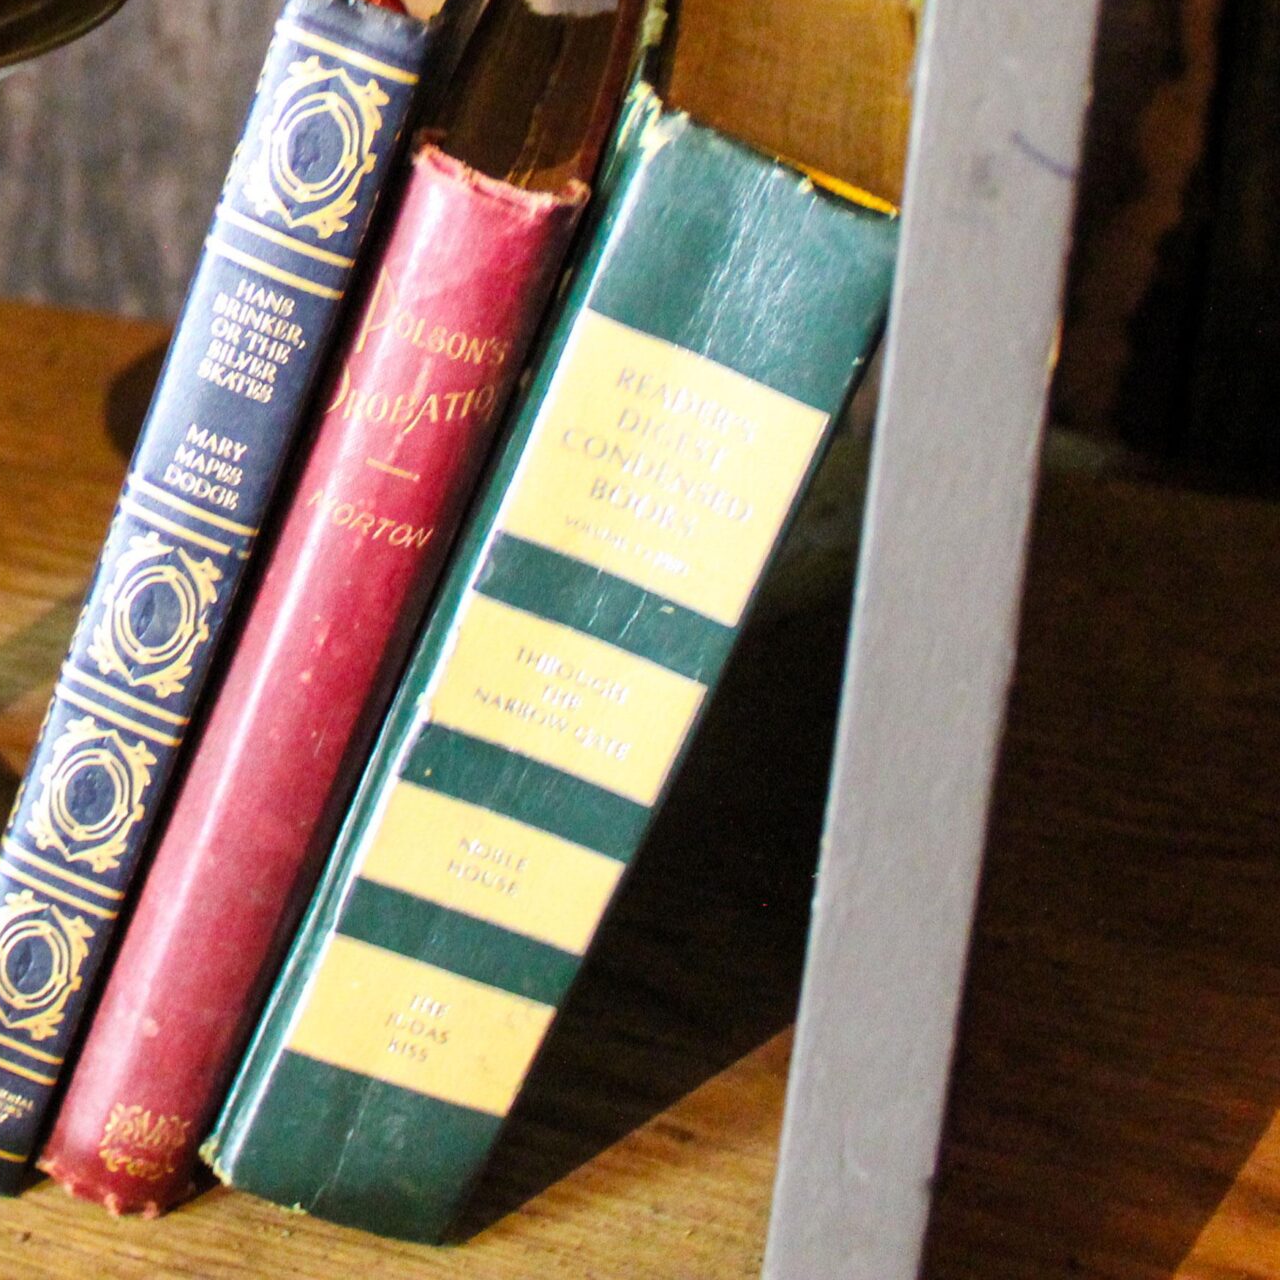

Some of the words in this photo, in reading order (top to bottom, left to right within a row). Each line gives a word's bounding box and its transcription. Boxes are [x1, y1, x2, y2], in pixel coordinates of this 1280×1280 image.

[236, 279, 296, 317] HANS
[211, 318, 241, 345] OR
[244, 330, 292, 365] THE
[212, 293, 306, 350] BRINKER,
[196, 357, 274, 404] SKATES
[207, 338, 278, 384] SILVER
[173, 444, 243, 486] MAPES
[185, 423, 248, 463] MARY
[163, 464, 240, 510] DODGE
[458, 837, 529, 872] NOBLE
[447, 859, 520, 896] HOUSE
